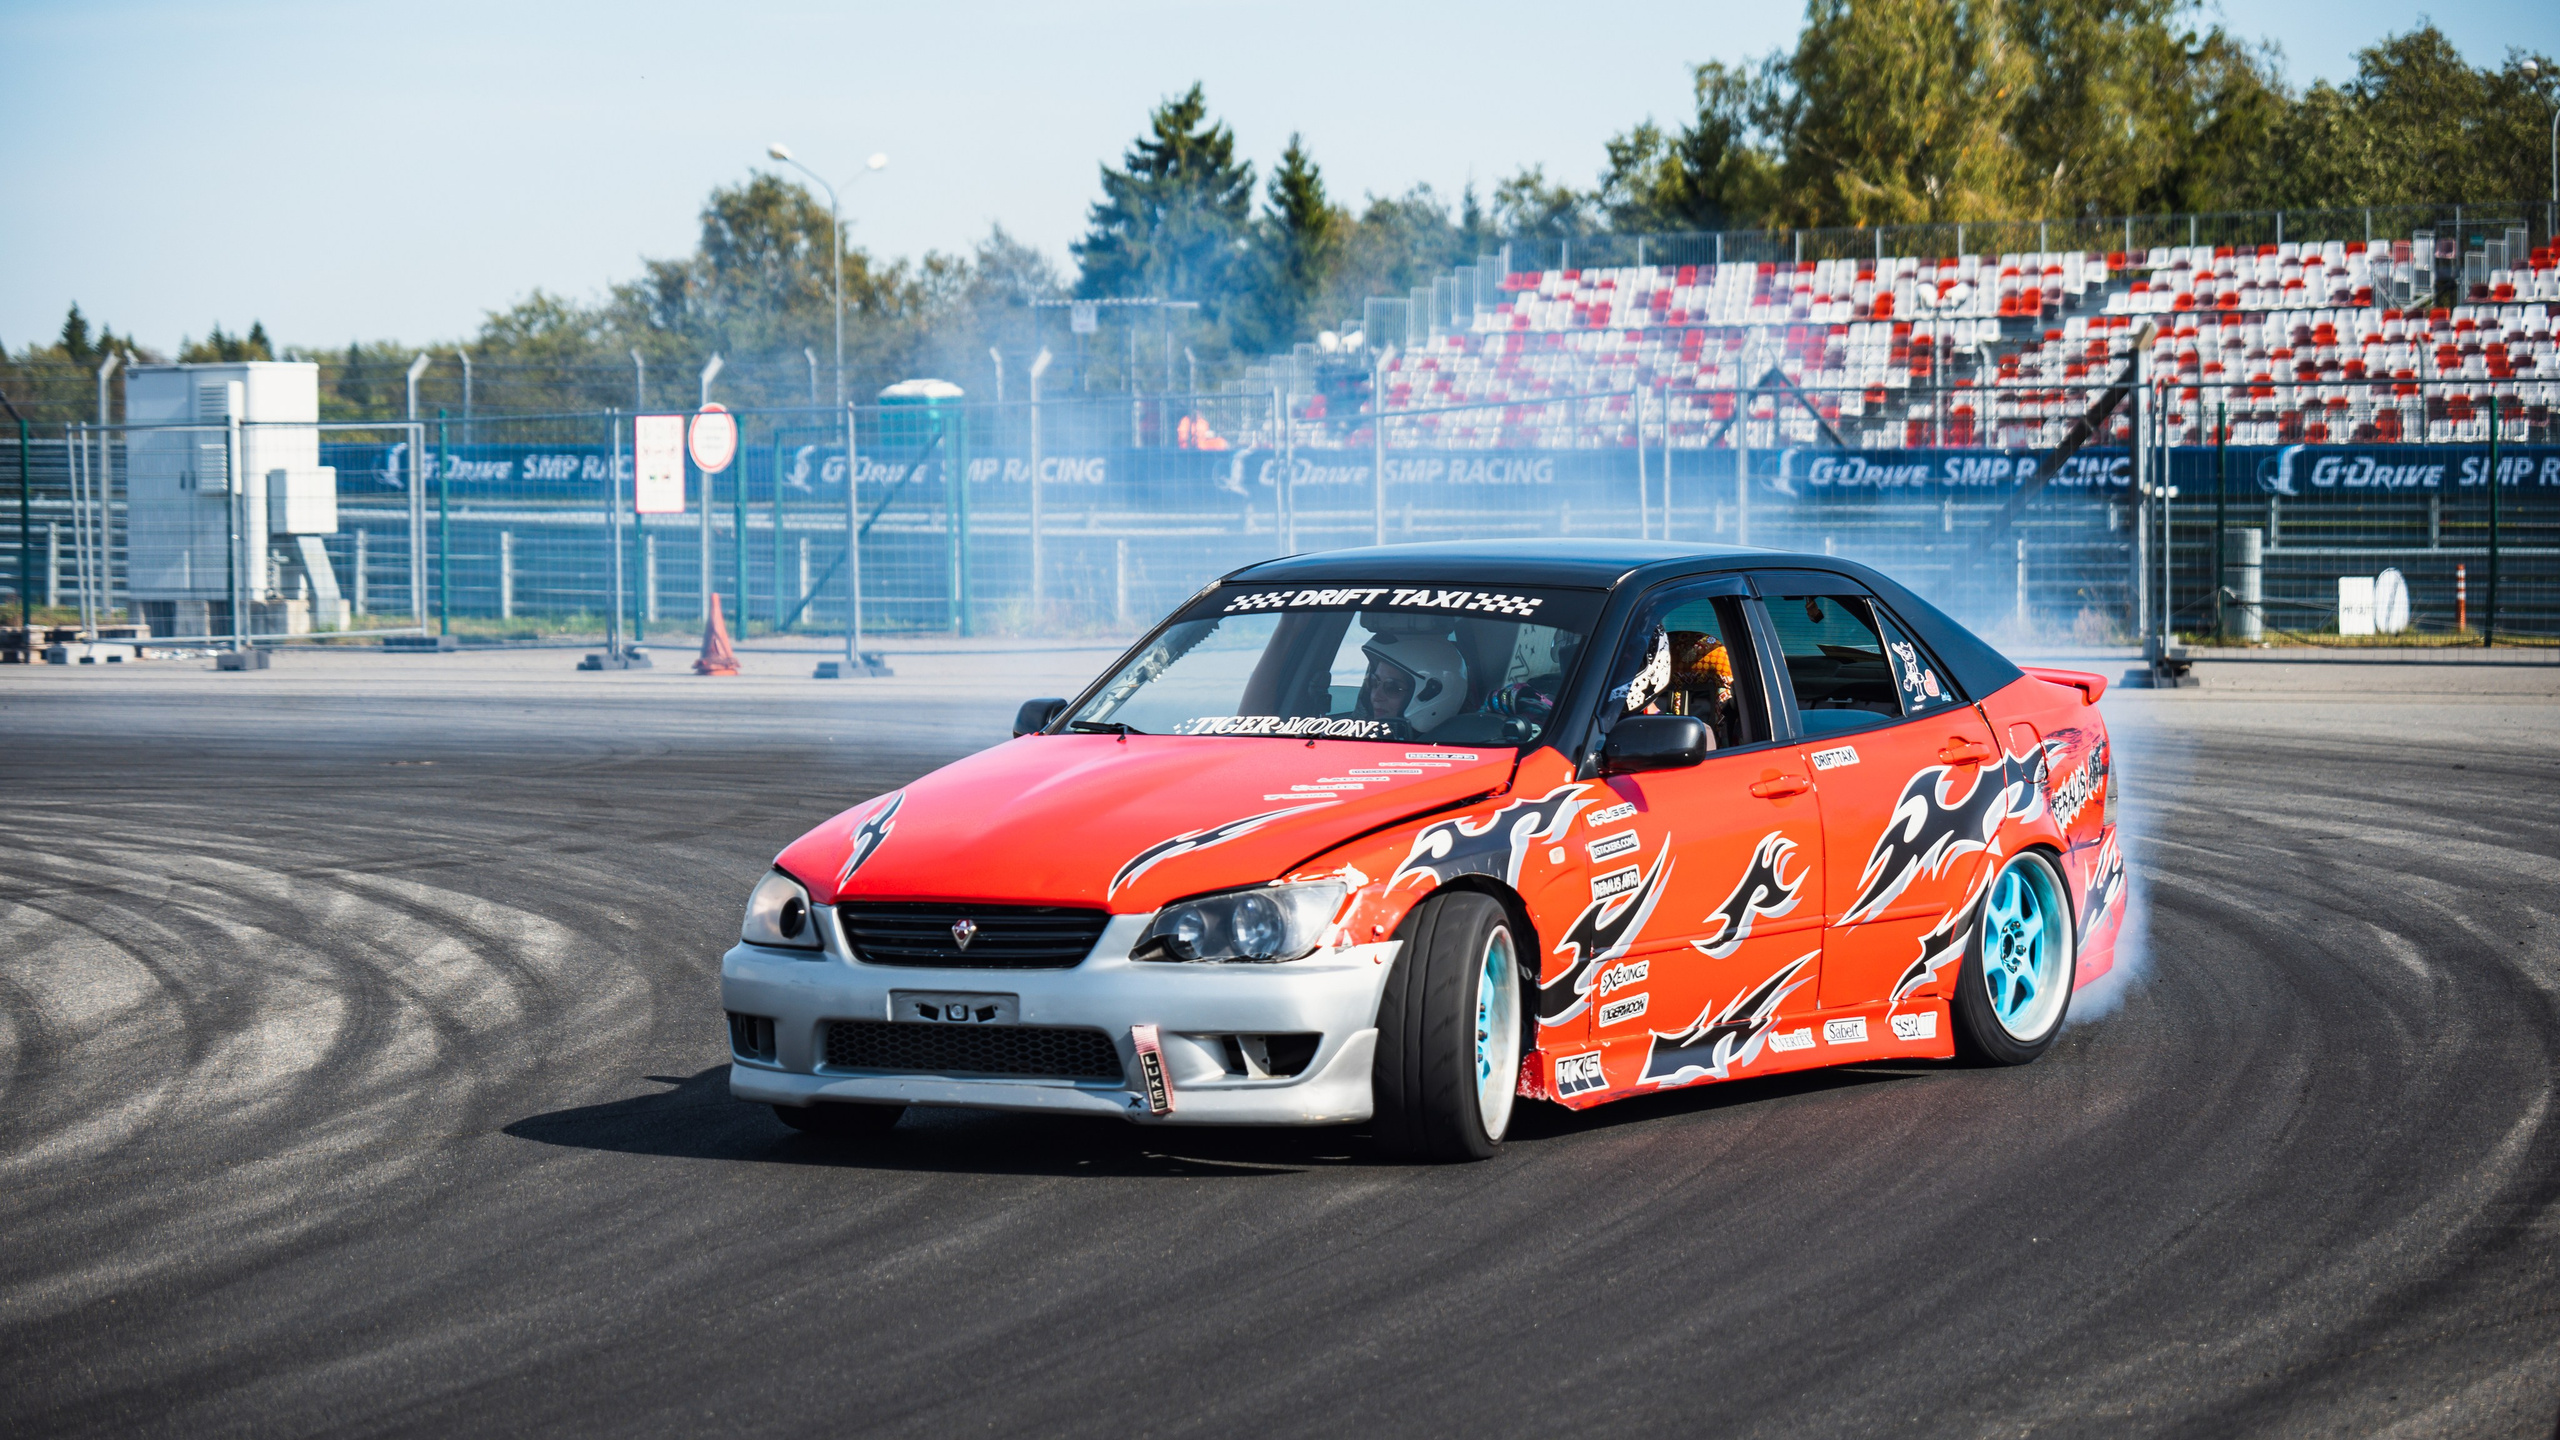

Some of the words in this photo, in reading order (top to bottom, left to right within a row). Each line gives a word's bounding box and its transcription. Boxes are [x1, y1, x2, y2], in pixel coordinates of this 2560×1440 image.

[522, 454, 579, 481] SMP
[1384, 459, 1443, 483] SMP
[1448, 458, 1553, 484] RACING
[1942, 457, 2009, 486] SMP
[2459, 456, 2534, 486] SMP
[1288, 588, 1389, 607] DRIFT
[1389, 589, 1470, 608] TAXI
[1813, 752, 1836, 768] DRIFT
[1834, 748, 1858, 763] TAXI
[1589, 803, 1635, 823] KRUGER
[1829, 1023, 1859, 1040] Sabelt
[1894, 1016, 1921, 1038] SSR
[1144, 1056, 1164, 1100] LUKE
[1558, 1053, 1600, 1085] HKS
